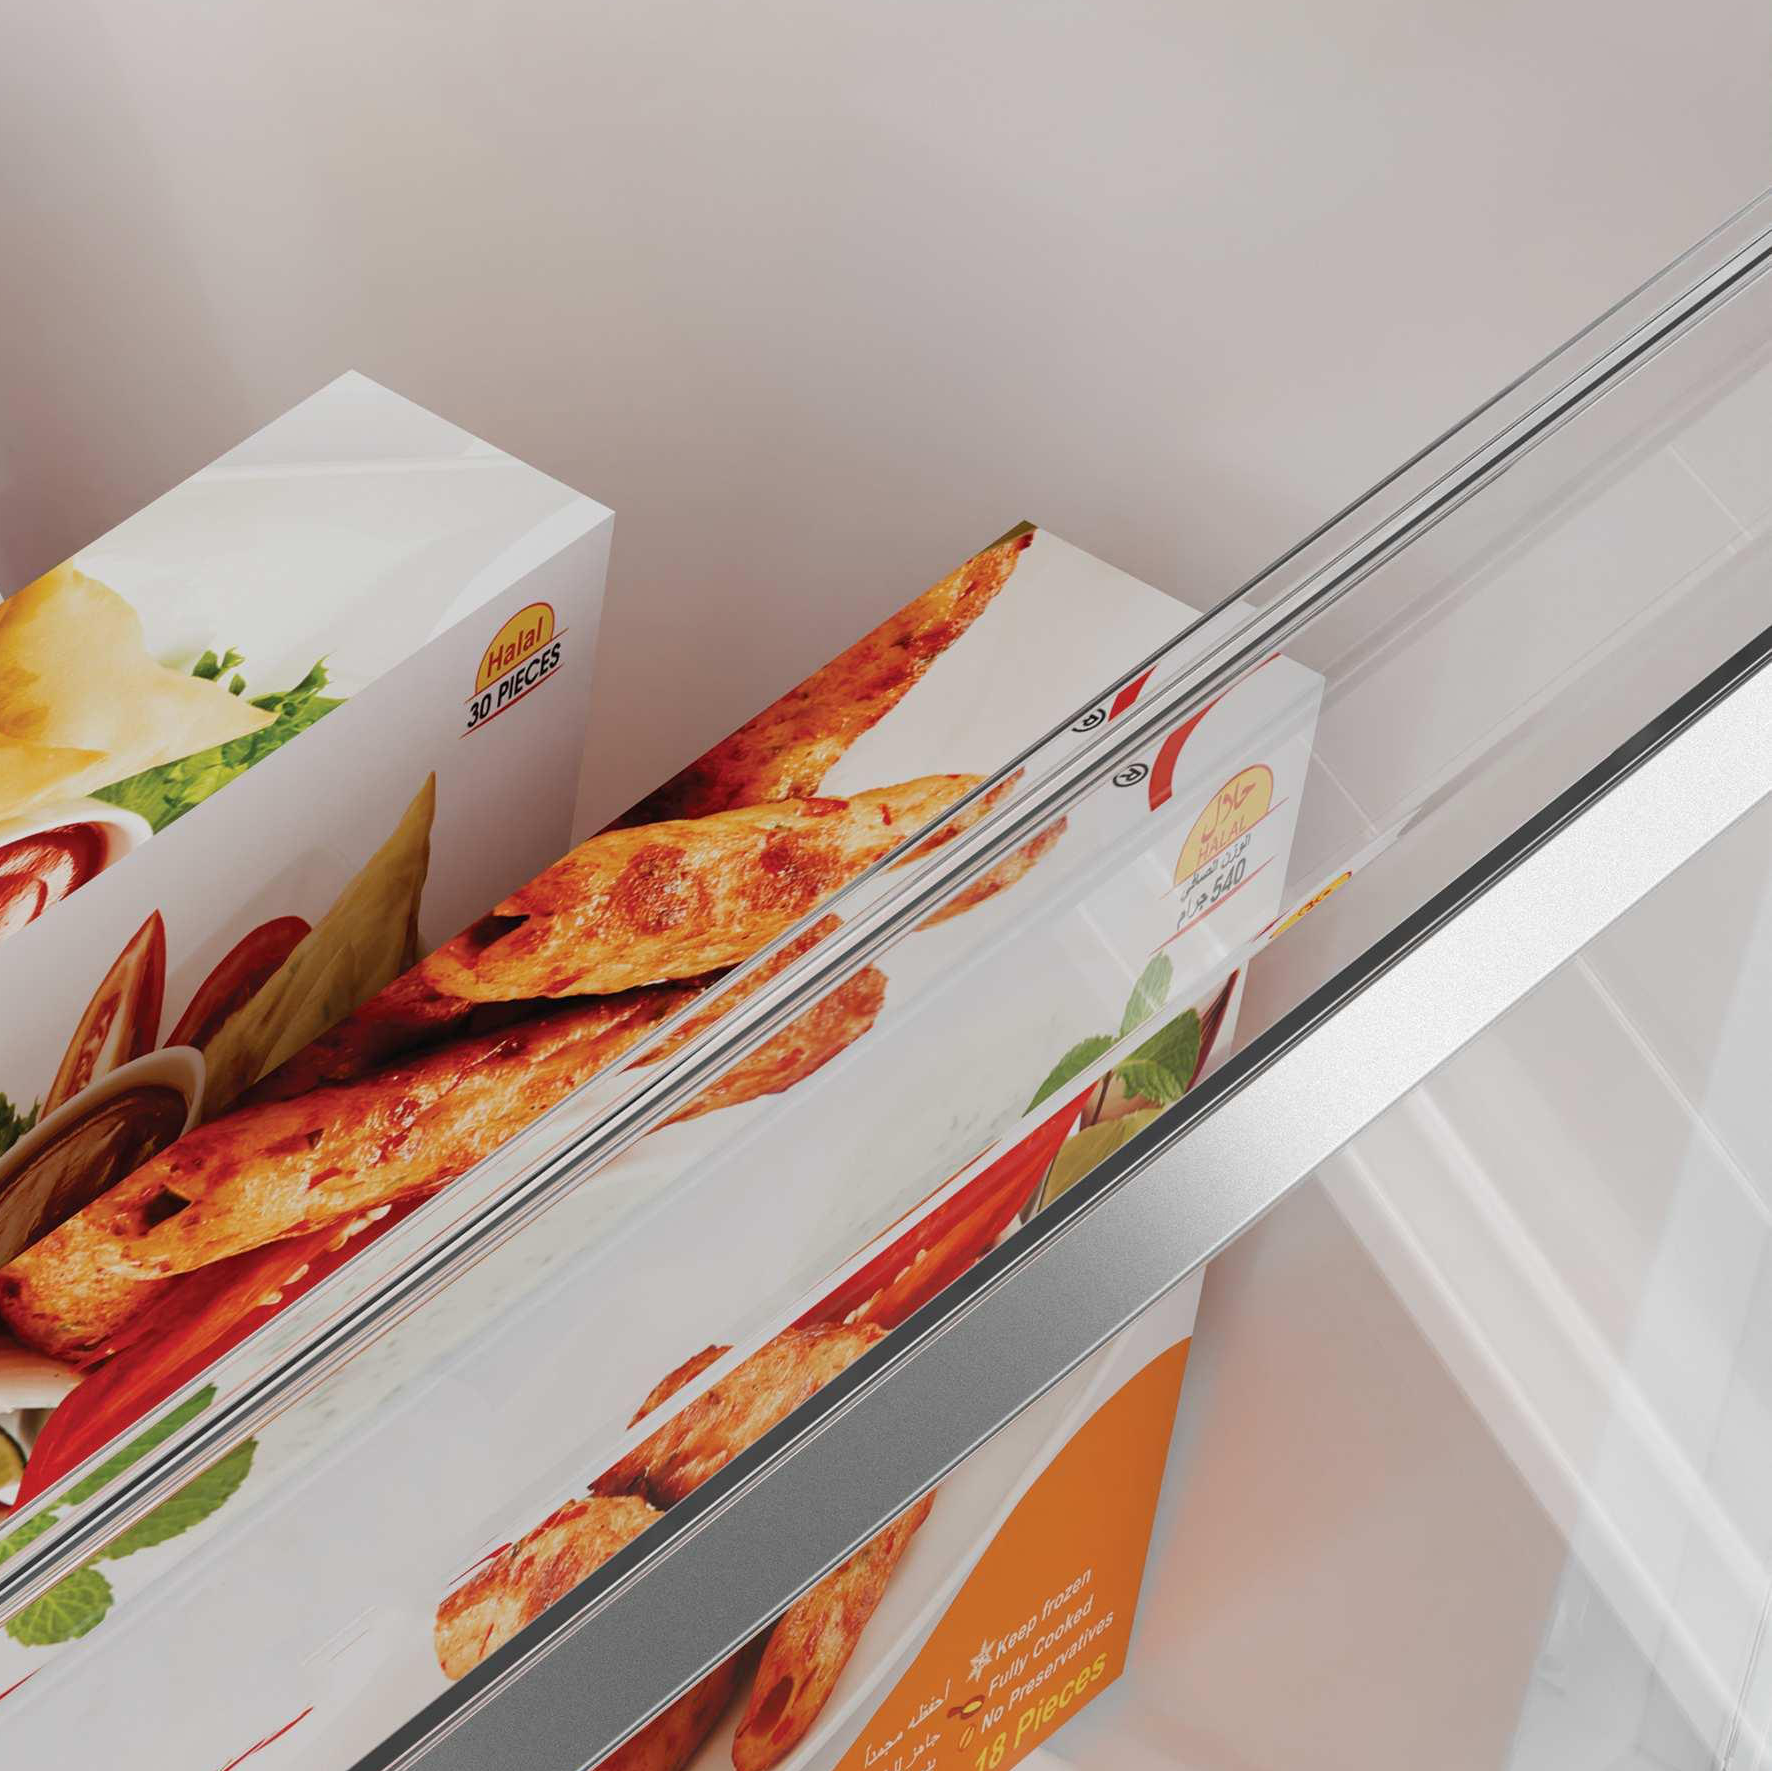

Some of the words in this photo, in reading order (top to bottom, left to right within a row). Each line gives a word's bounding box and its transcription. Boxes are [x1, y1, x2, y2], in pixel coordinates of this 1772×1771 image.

[467, 692, 491, 728] 30
[497, 642, 561, 707] PIECES
[487, 615, 544, 678] Halal
[1197, 814, 1247, 868] HALAL
[1210, 857, 1247, 903] 540
[988, 1653, 1029, 1698] Fully
[1032, 1594, 1094, 1658] Cooked
[996, 1615, 1037, 1659] Keep
[1041, 1568, 1092, 1620] frozen
[981, 1704, 1005, 1733] No
[1008, 1611, 1114, 1710] Preservatives
[1014, 1651, 1107, 1749] Pieces
